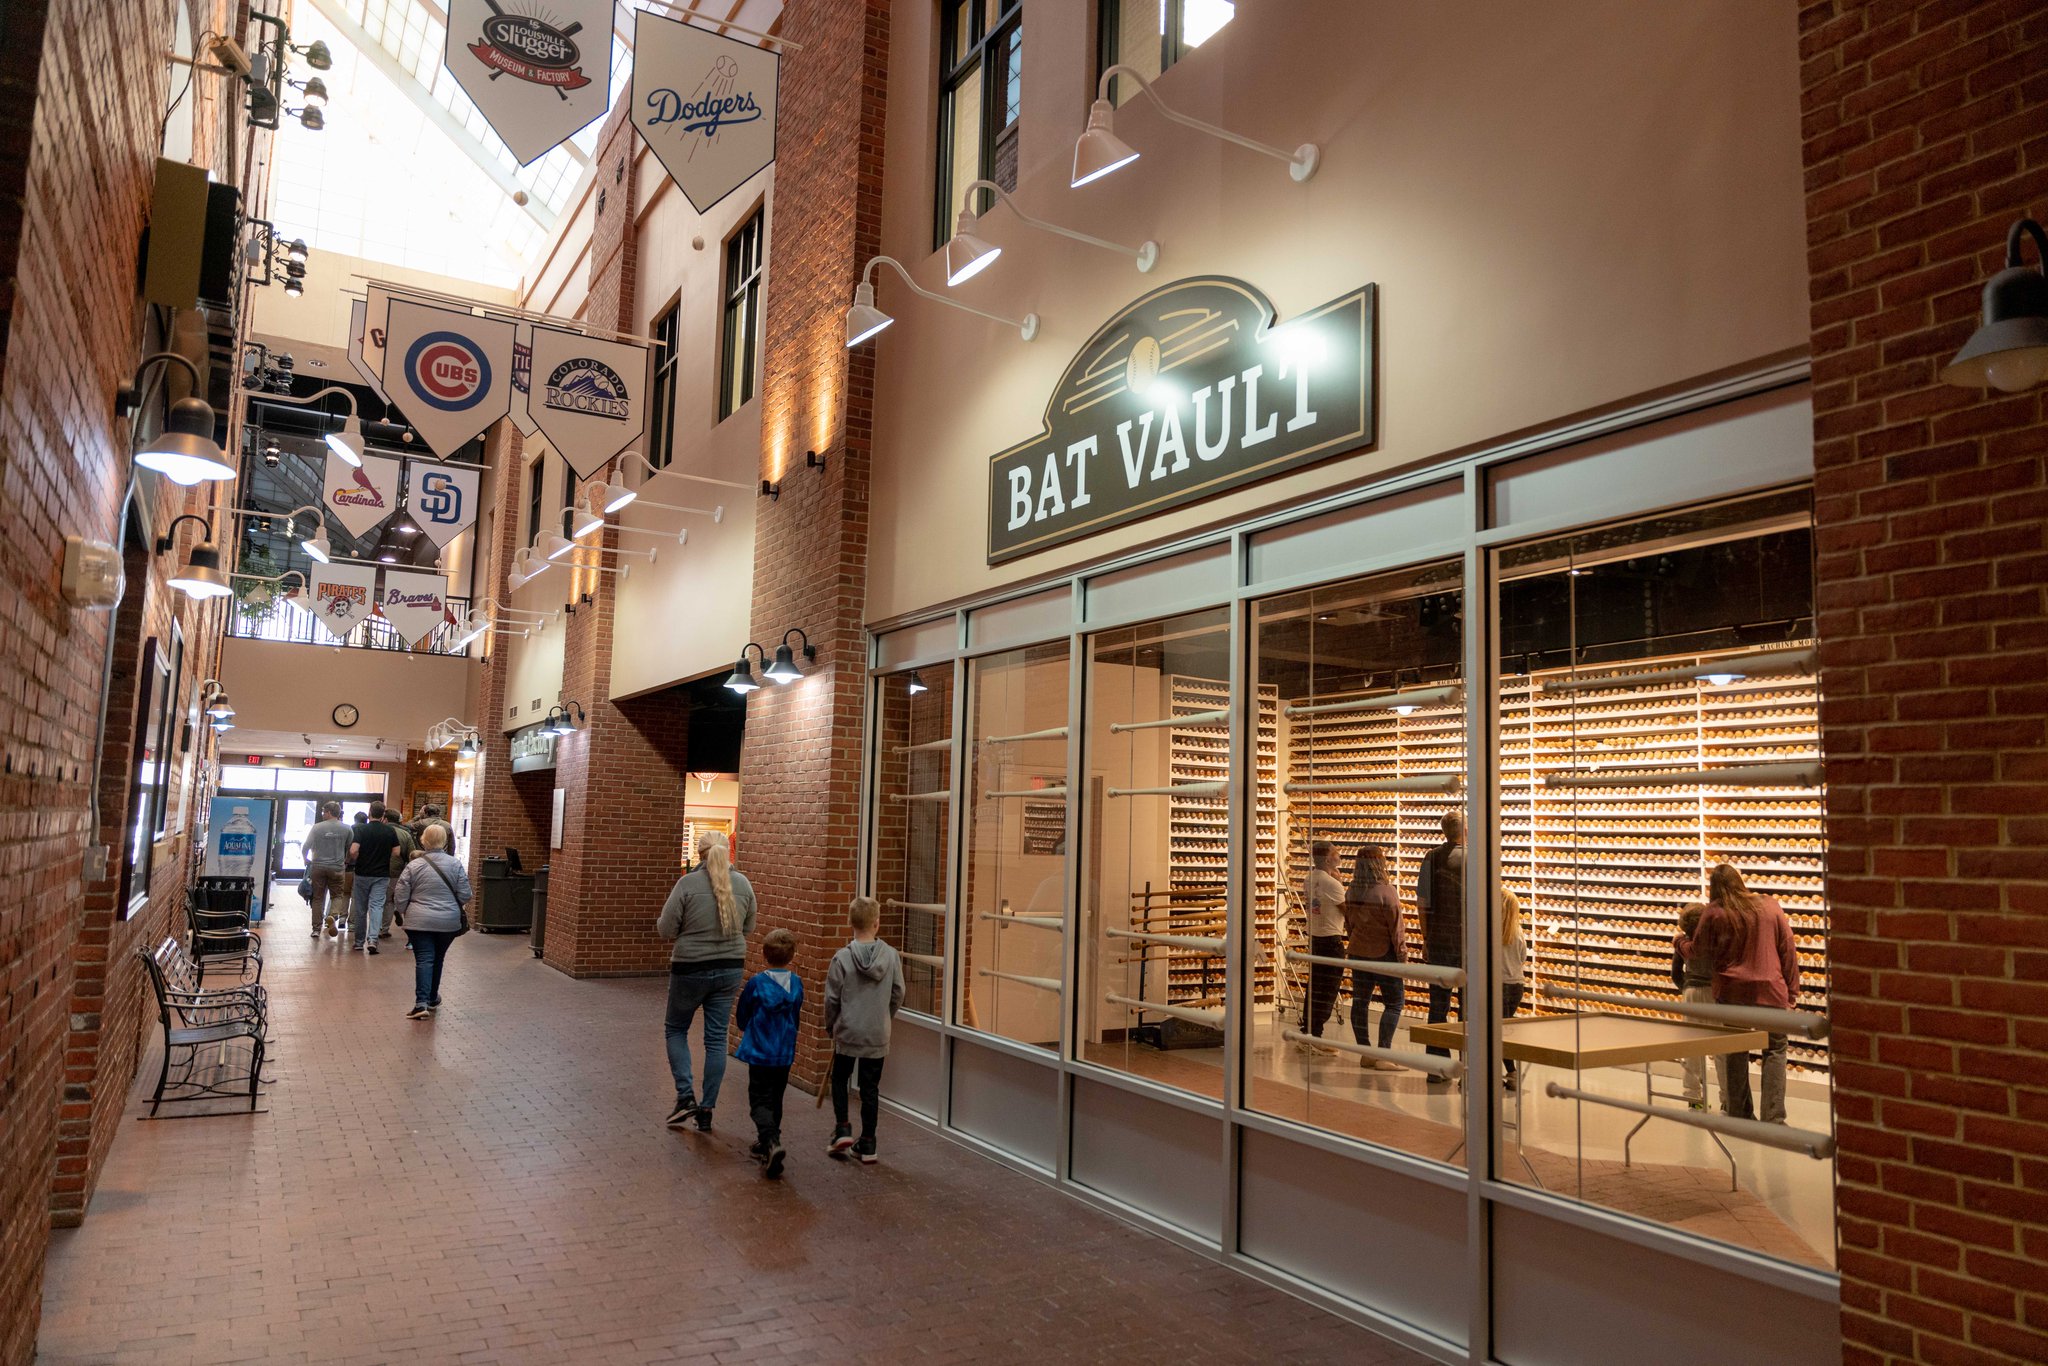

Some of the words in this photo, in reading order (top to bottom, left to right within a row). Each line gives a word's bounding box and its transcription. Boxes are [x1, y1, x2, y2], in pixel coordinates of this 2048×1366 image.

[496, 23, 568, 59] Slugger
[515, 25, 566, 47] LOUISVILLE
[489, 50, 526, 75] MUSEUM
[537, 69, 570, 82] FACTORY
[647, 88, 762, 137] Dodgers
[420, 345, 478, 398] CUBS
[552, 360, 625, 393] COLORADO
[546, 387, 629, 417] ROCKIES
[1007, 434, 1098, 532] BAT
[1116, 345, 1326, 489] VAULT
[332, 488, 386, 508] Cardinals
[420, 472, 462, 524] SD
[318, 583, 366, 605] PIRATES
[387, 589, 434, 606] Braves
[1760, 641, 1795, 650] MACHINE
[248, 756, 260, 764] EXIT
[305, 758, 316, 766] EXIT
